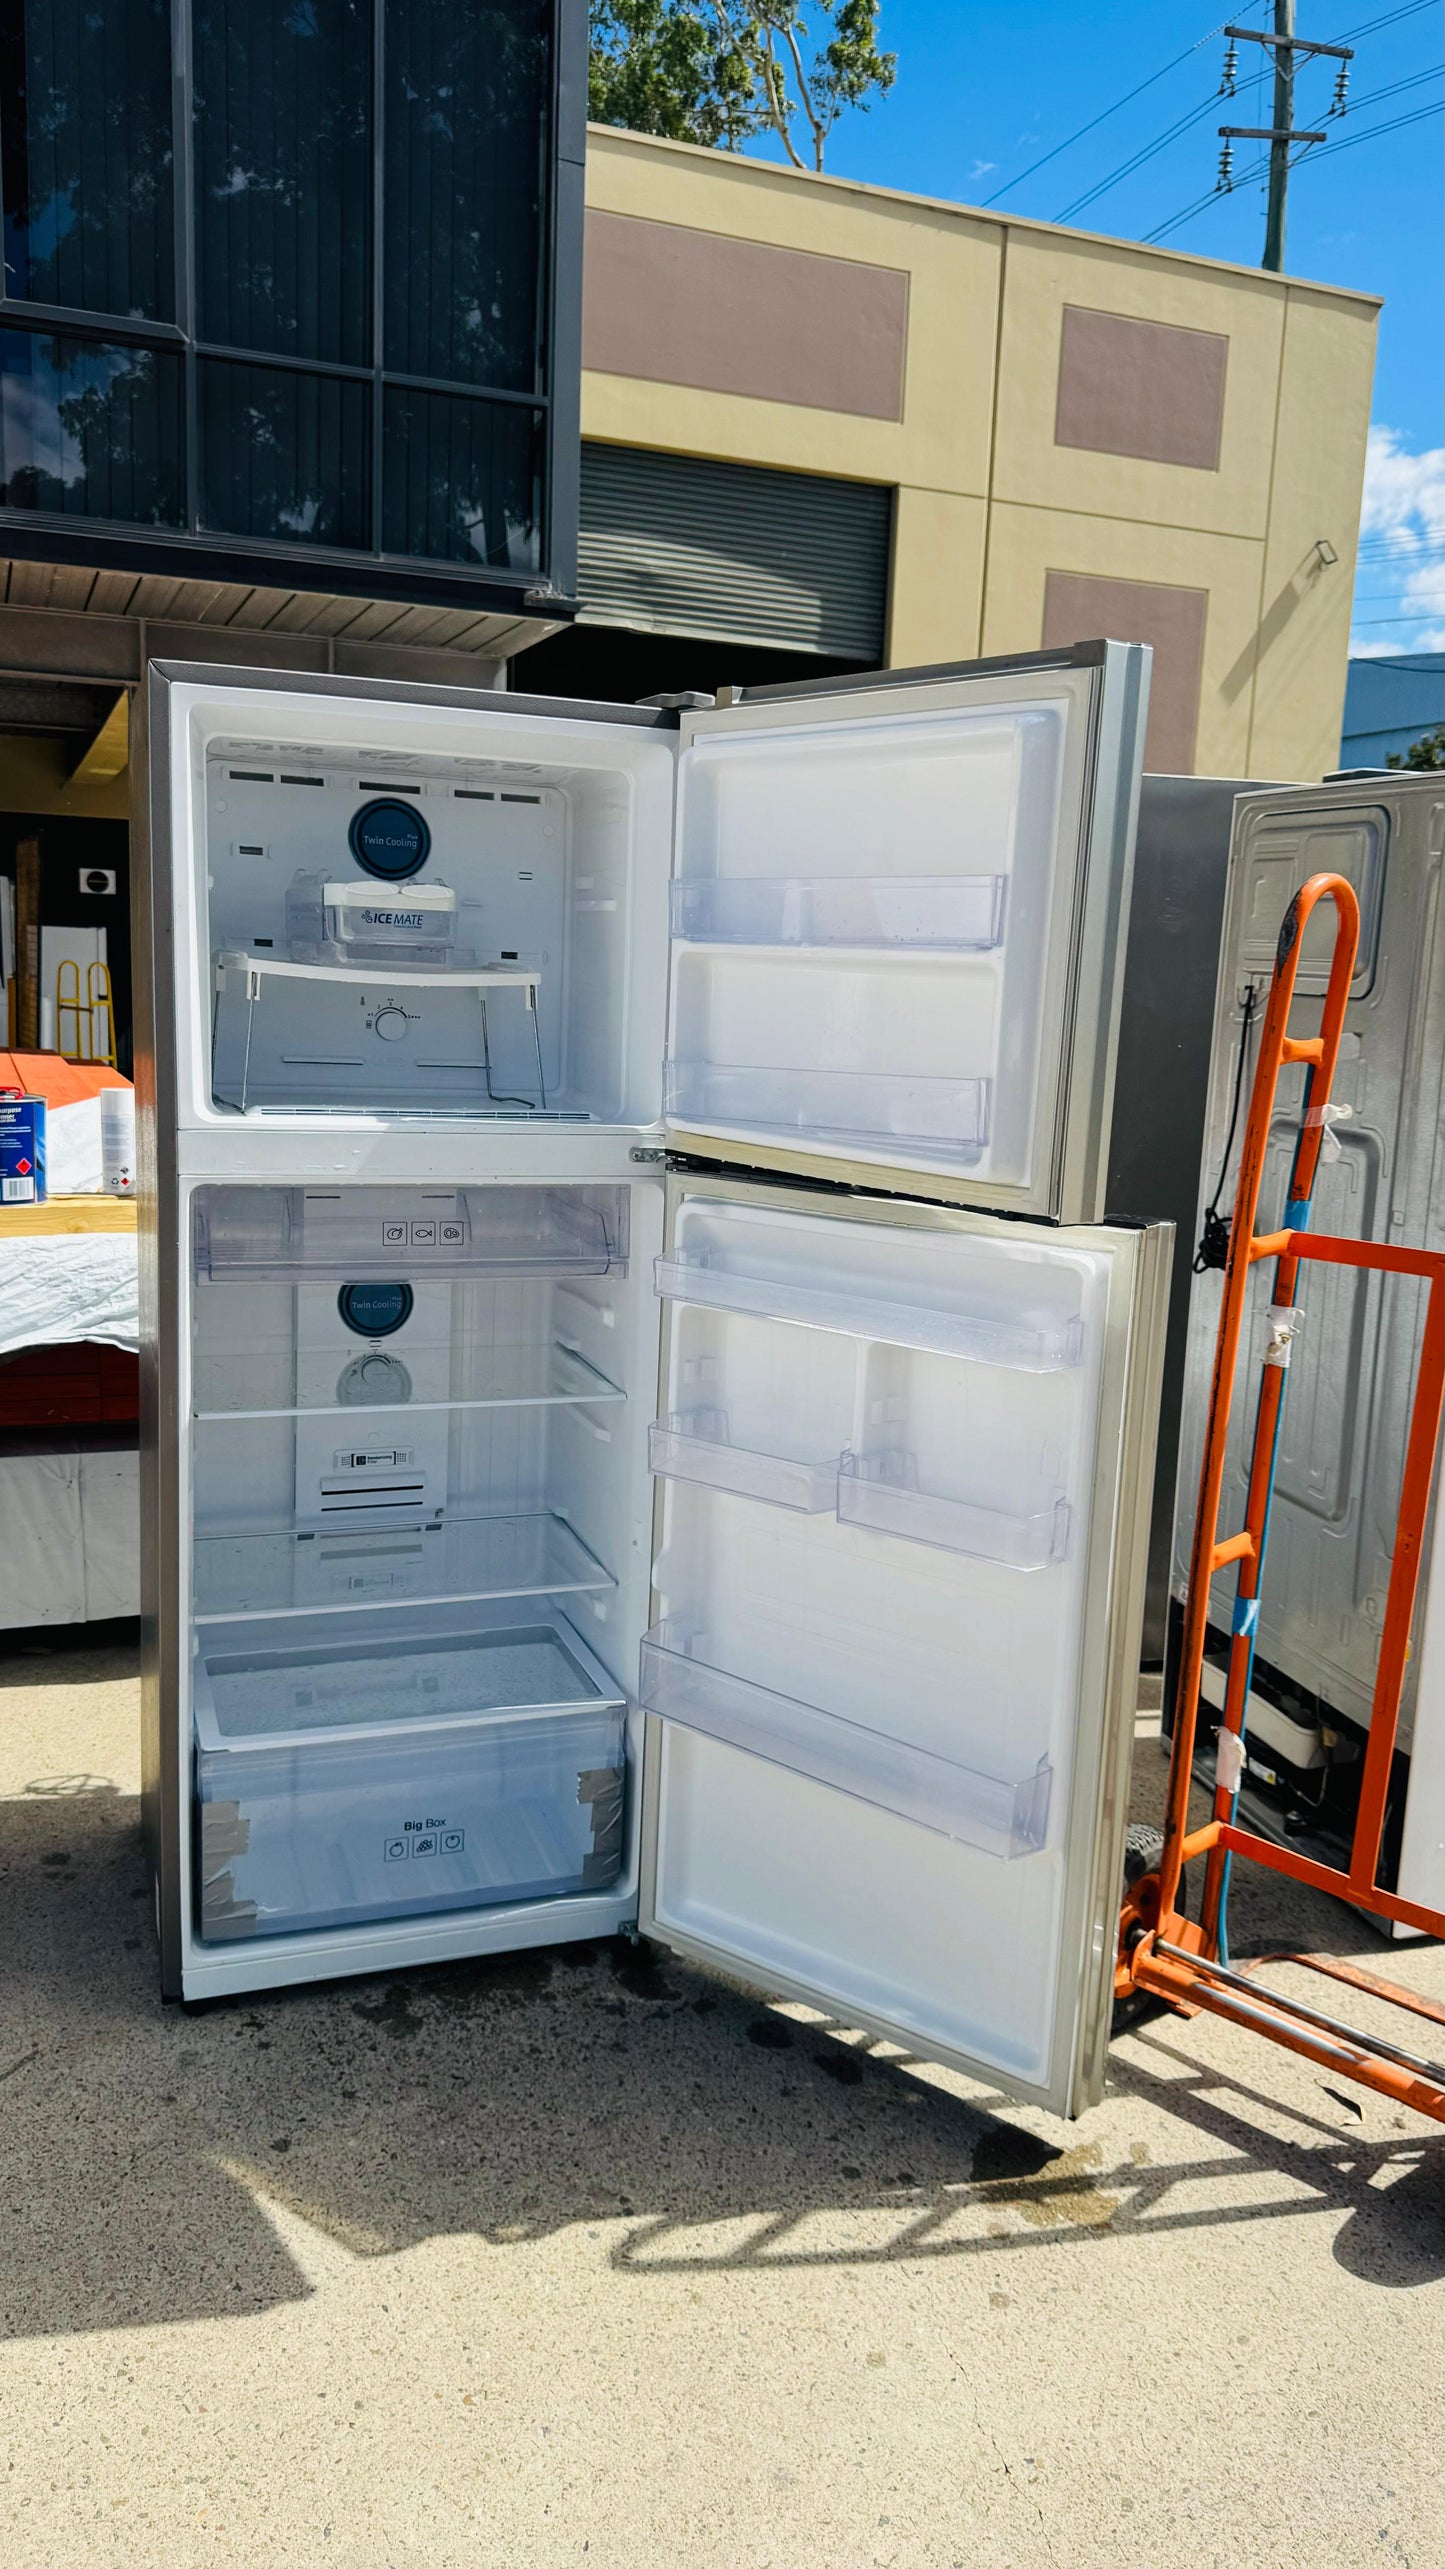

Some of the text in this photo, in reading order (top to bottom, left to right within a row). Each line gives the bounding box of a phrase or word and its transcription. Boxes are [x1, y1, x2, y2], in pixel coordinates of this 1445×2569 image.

[364, 835, 417, 850] Twin Cooling
[373, 913, 424, 926] ICE MATE
[352, 1300, 402, 1310] Twin Cooling
[404, 1818, 447, 1832] Big Box
